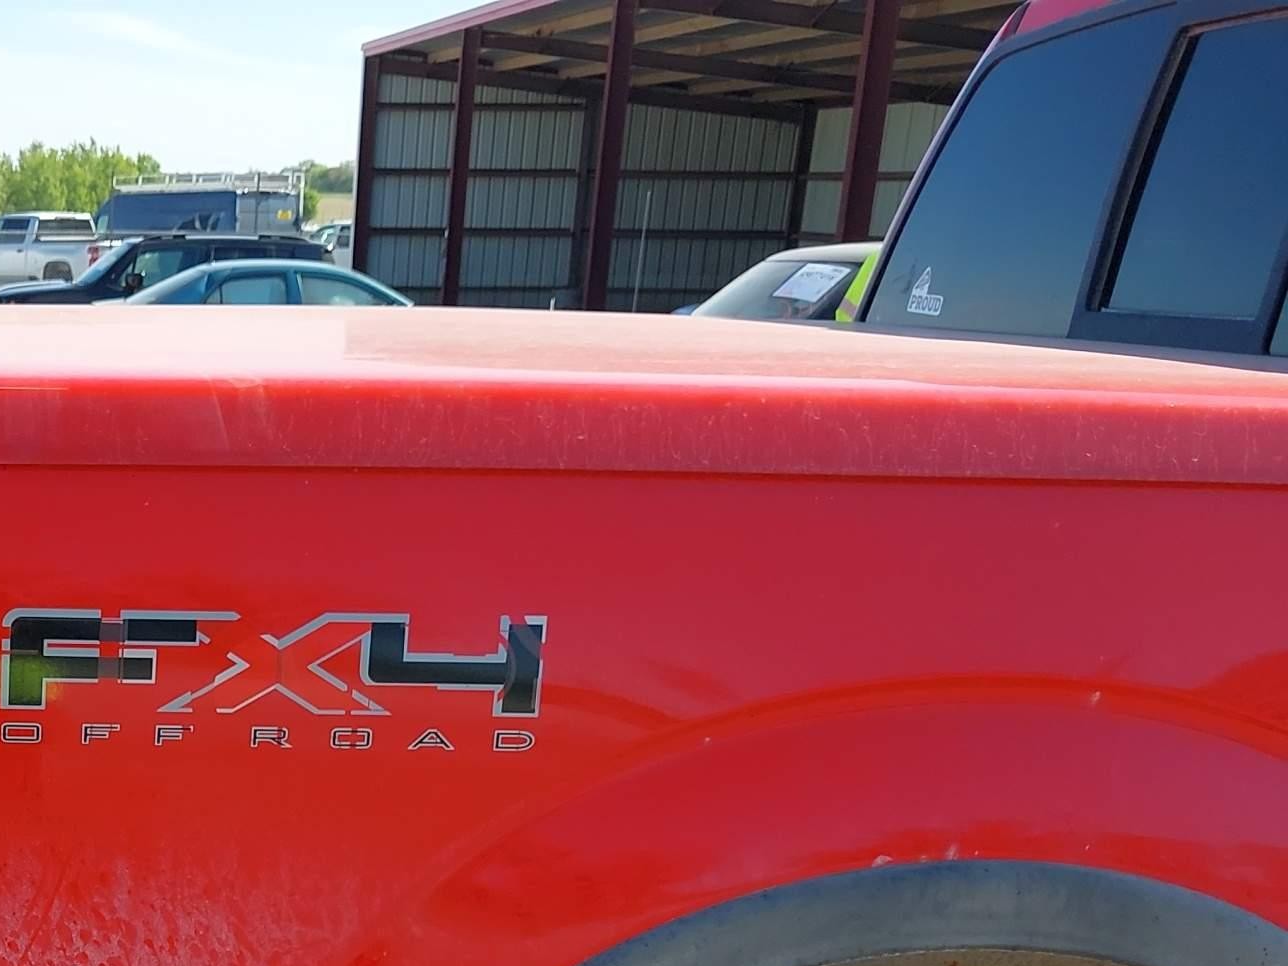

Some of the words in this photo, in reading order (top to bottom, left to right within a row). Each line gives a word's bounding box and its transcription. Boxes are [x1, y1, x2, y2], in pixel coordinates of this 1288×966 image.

[909, 294, 942, 313] PROUD
[0, 608, 547, 717] FX4
[1, 722, 194, 746] OFF
[250, 725, 536, 752] ROAD
